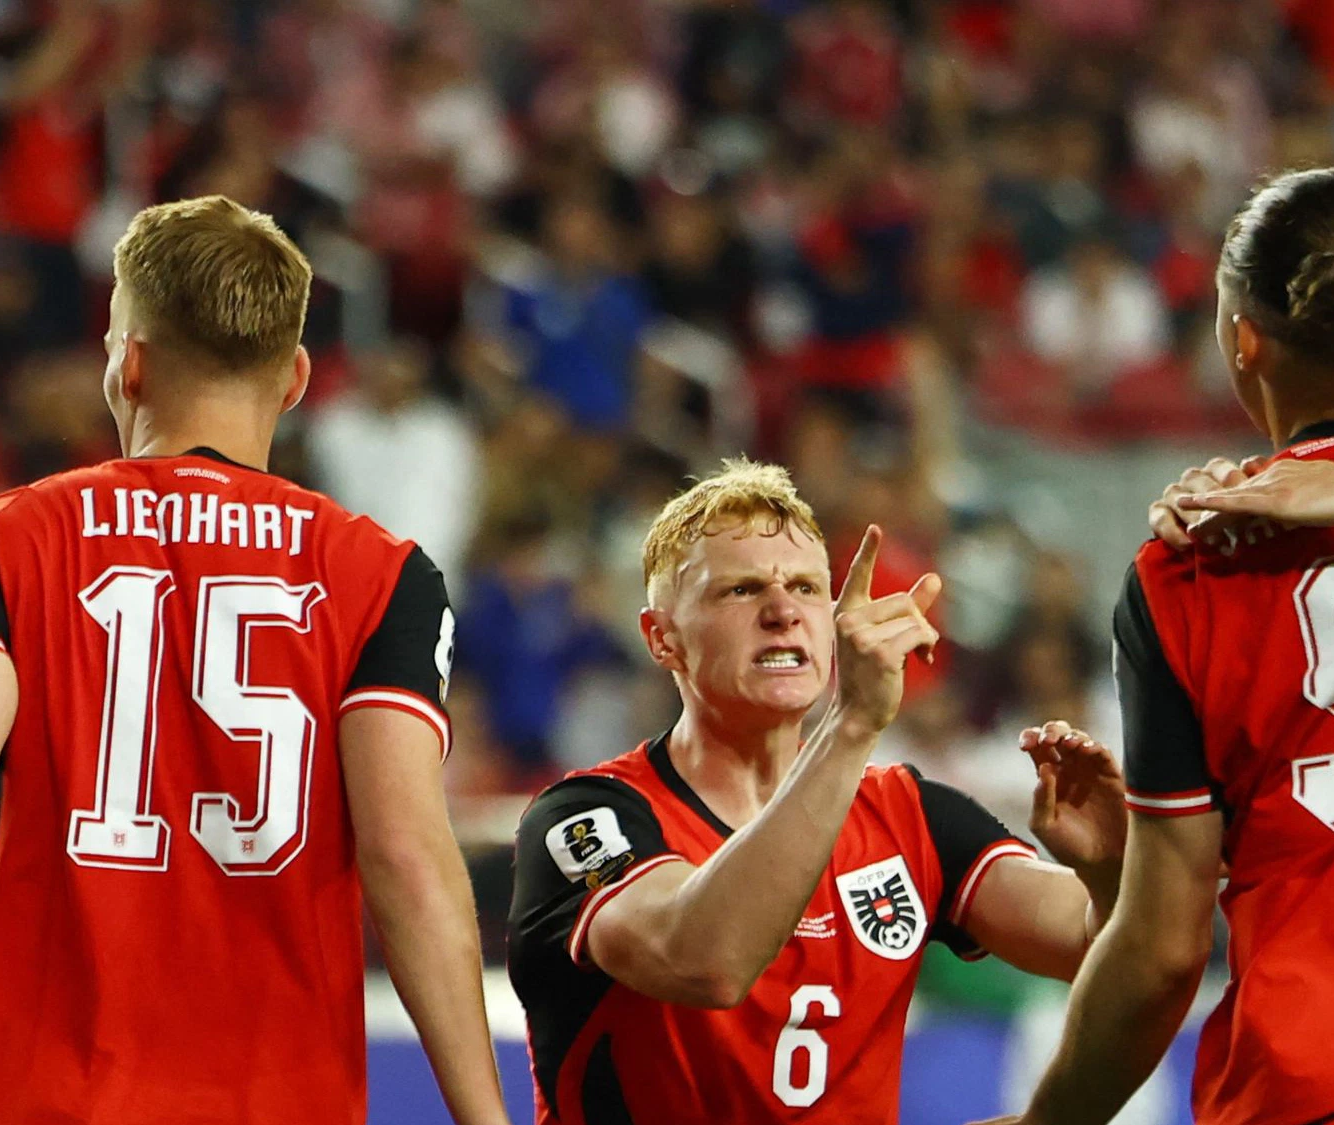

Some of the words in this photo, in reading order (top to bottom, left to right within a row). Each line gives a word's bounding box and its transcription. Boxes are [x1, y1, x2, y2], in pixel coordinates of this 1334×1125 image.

[80, 487, 315, 556] LIENHART
[66, 565, 328, 876] 15
[772, 985, 841, 1108] 6
